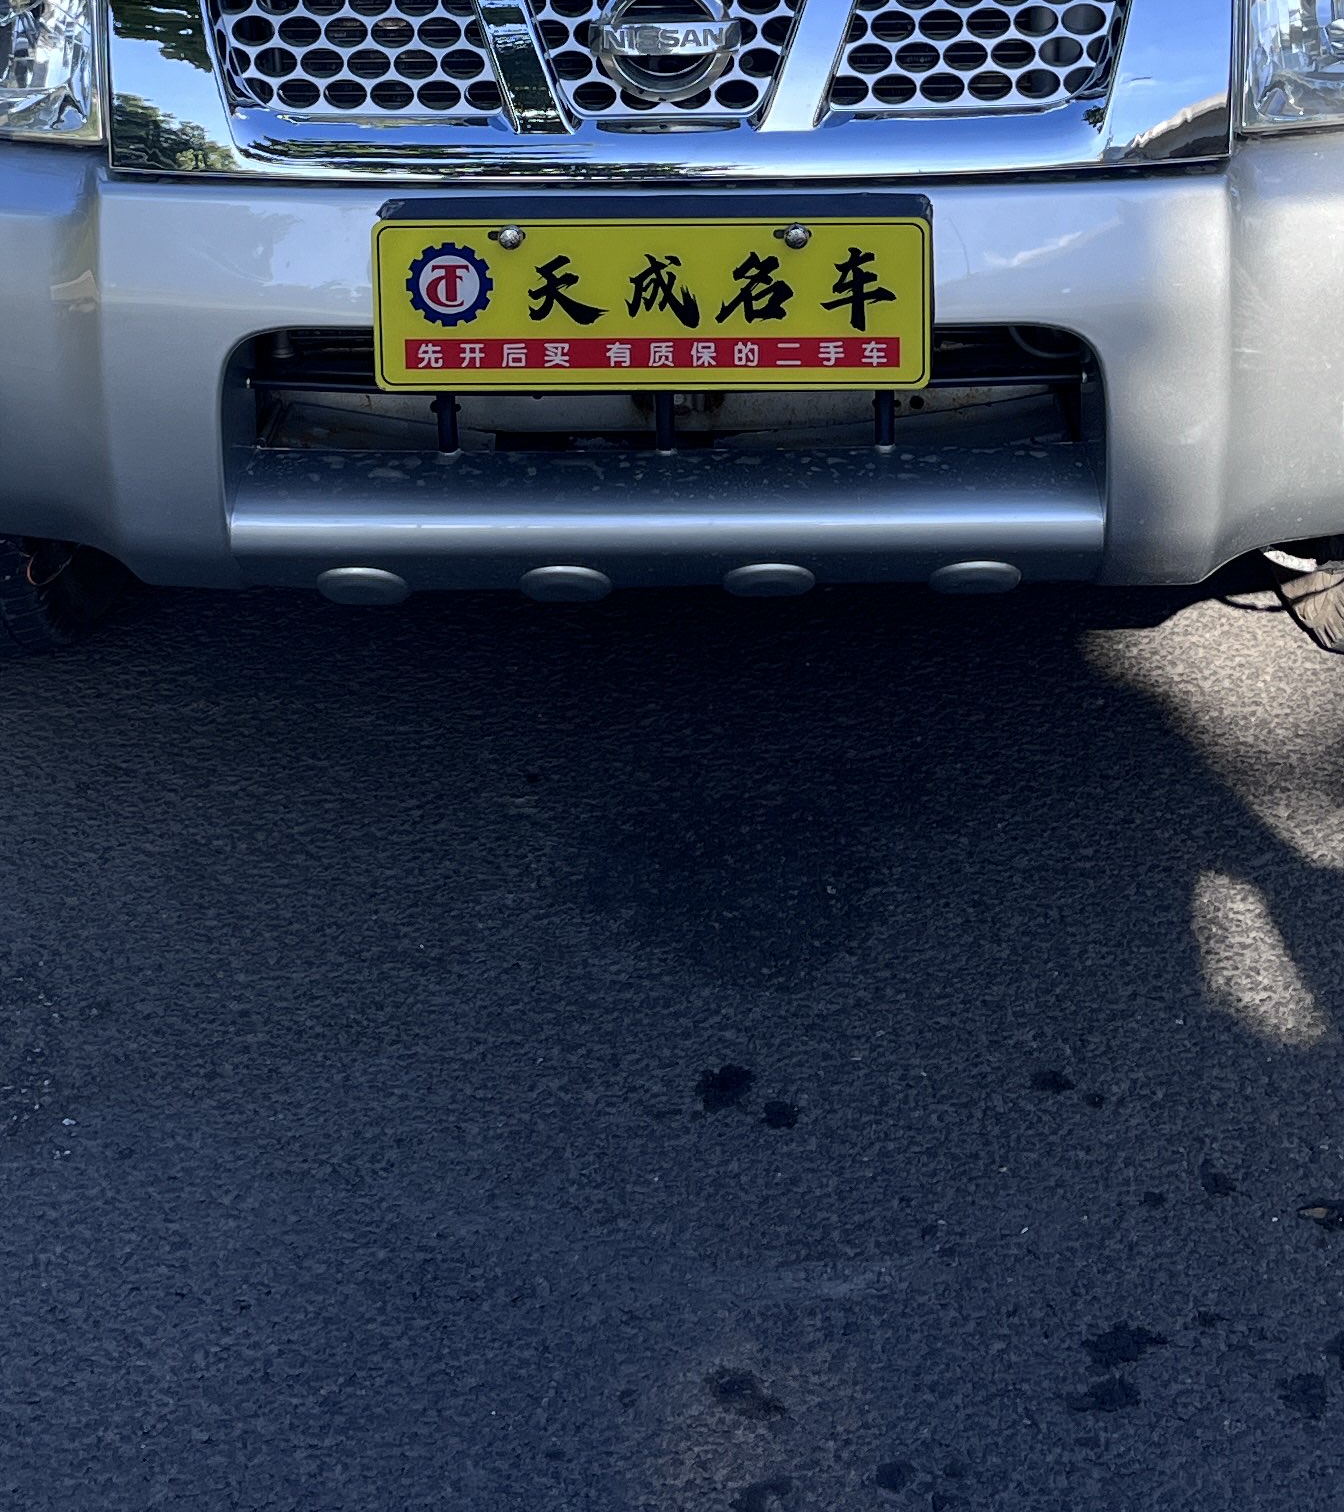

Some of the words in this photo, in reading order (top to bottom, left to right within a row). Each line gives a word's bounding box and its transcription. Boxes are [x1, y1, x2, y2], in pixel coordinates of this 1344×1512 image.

[605, 25, 725, 49] NISSAN
[528, 246, 897, 332] 天成名车
[417, 342, 571, 368] 先开后买
[605, 341, 889, 368] 有质保的二手车
